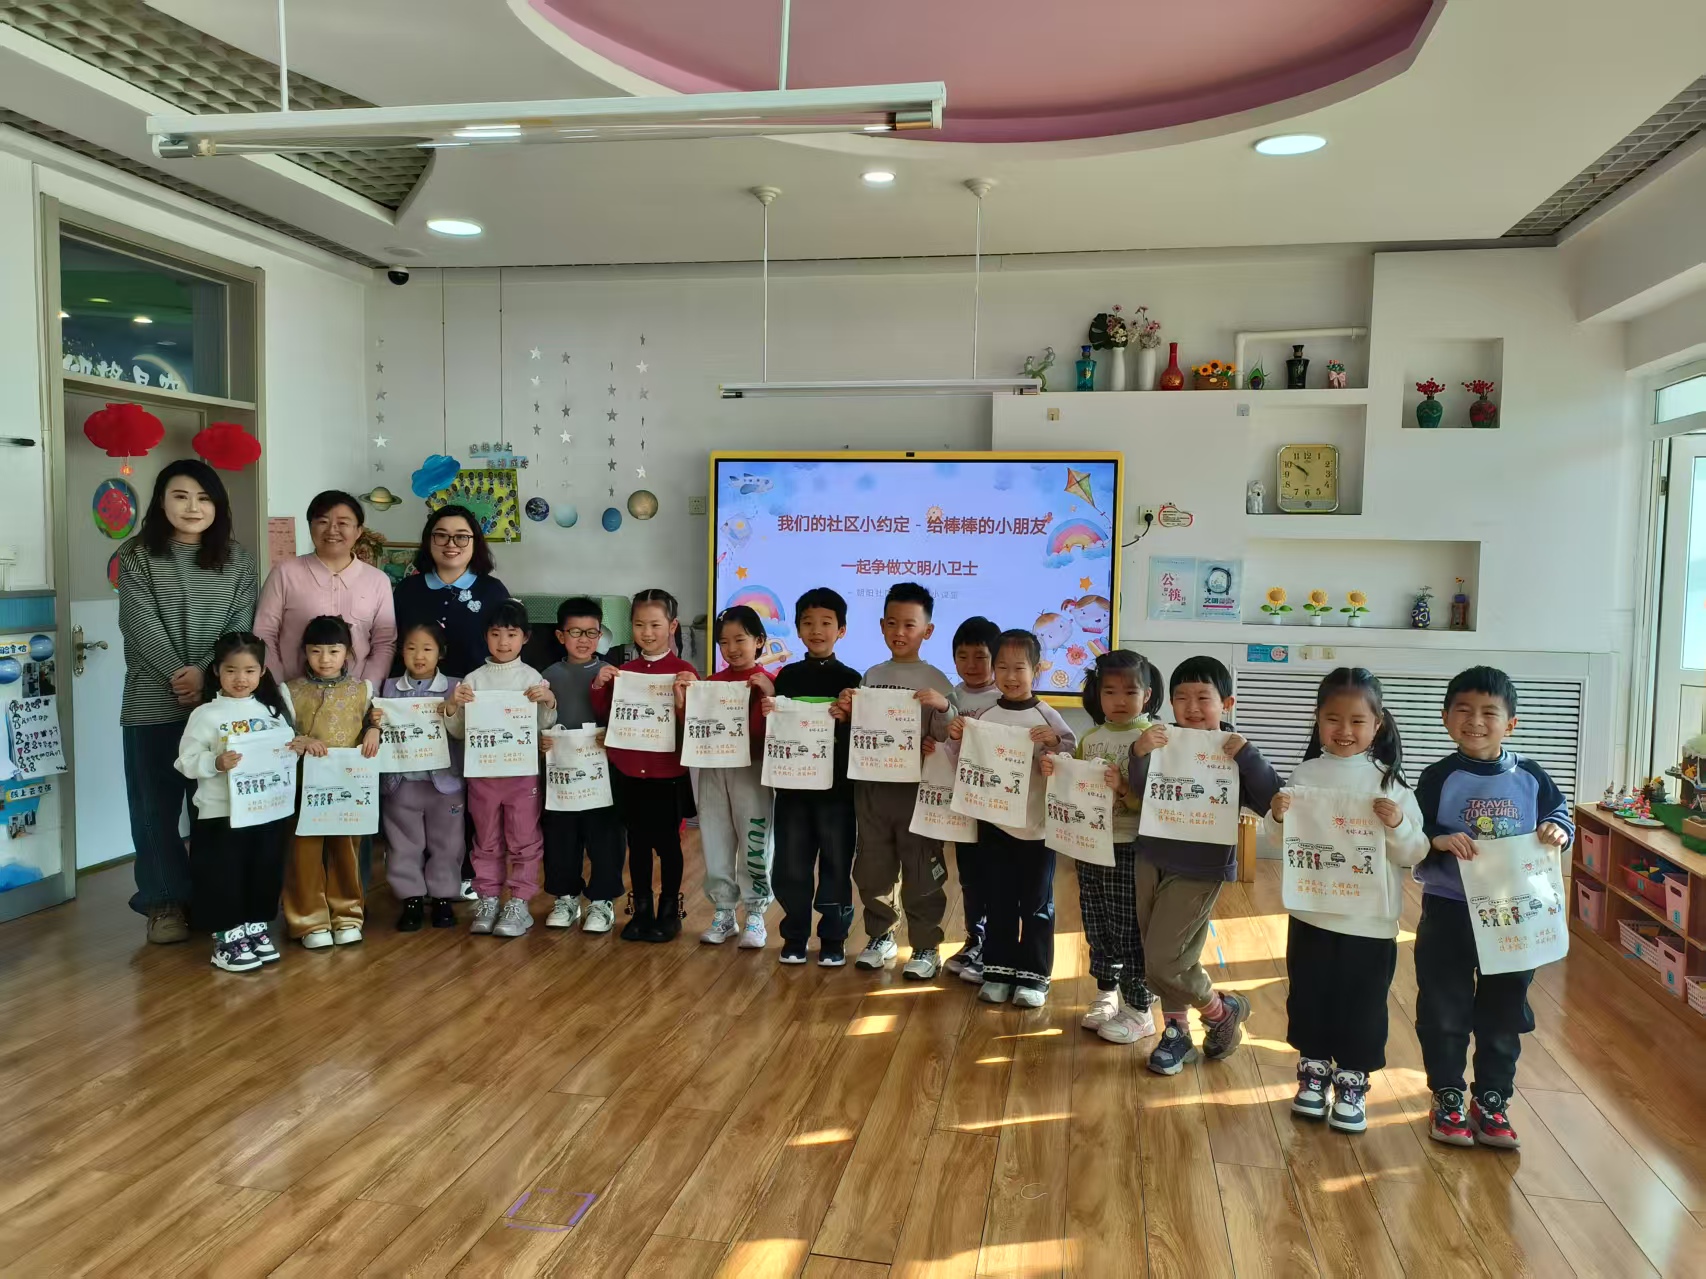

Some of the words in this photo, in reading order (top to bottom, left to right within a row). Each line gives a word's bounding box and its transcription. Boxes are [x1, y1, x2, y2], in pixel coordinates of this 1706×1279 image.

[778, 514, 910, 533] 我们的社区小约定
[926, 516, 1047, 535] 给棒棒的小朋友
[841, 558, 978, 576] 一起争做文明小卫士
[1468, 800, 1514, 808] TRAVEL
[1464, 807, 1518, 820] TOGETHER
[747, 818, 769, 897] YUXING
